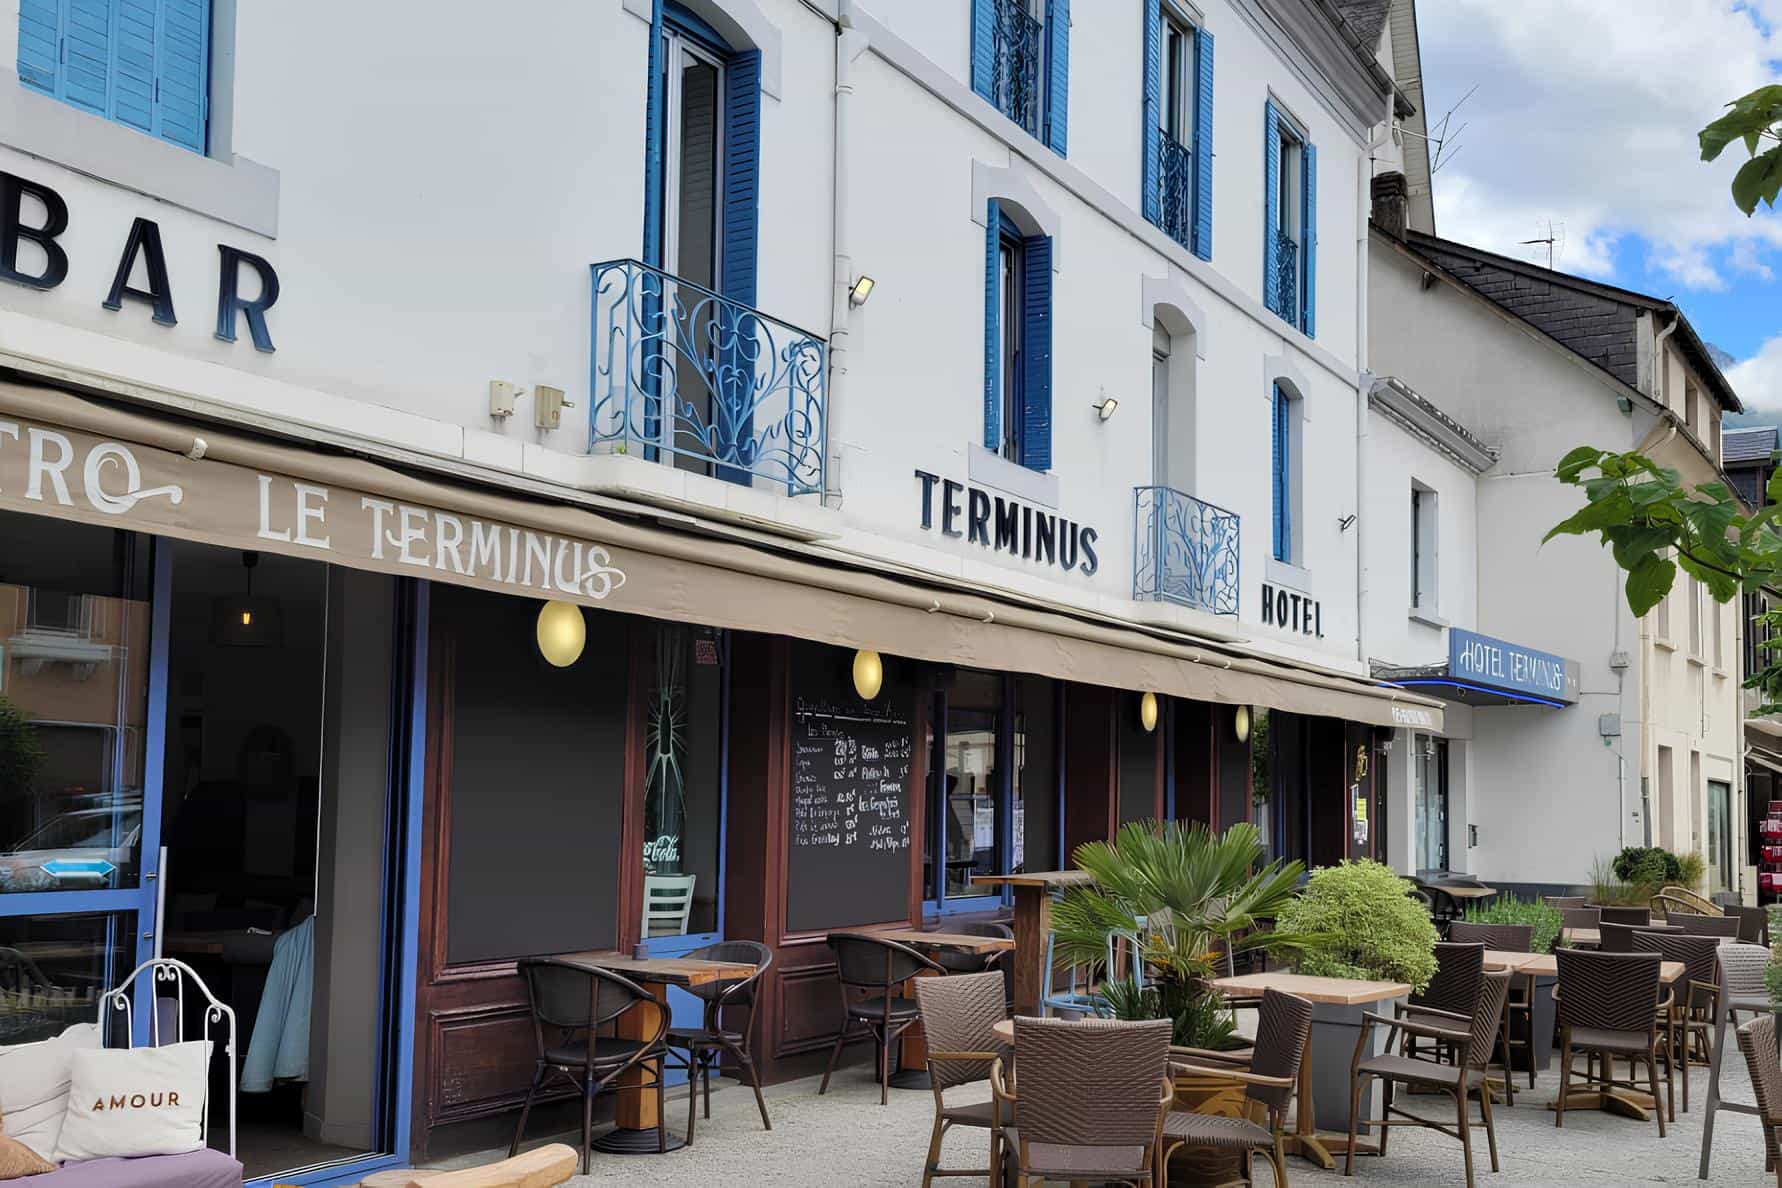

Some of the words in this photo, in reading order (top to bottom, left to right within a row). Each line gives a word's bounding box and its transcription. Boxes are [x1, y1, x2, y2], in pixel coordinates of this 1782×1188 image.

[0, 170, 281, 354] BAR
[256, 475, 330, 549] LE
[361, 496, 627, 599] TERMINUS
[914, 469, 1099, 577] TERMINUS
[1460, 639, 1505, 679] HOTEL
[92, 1091, 180, 1112] AMOUR
